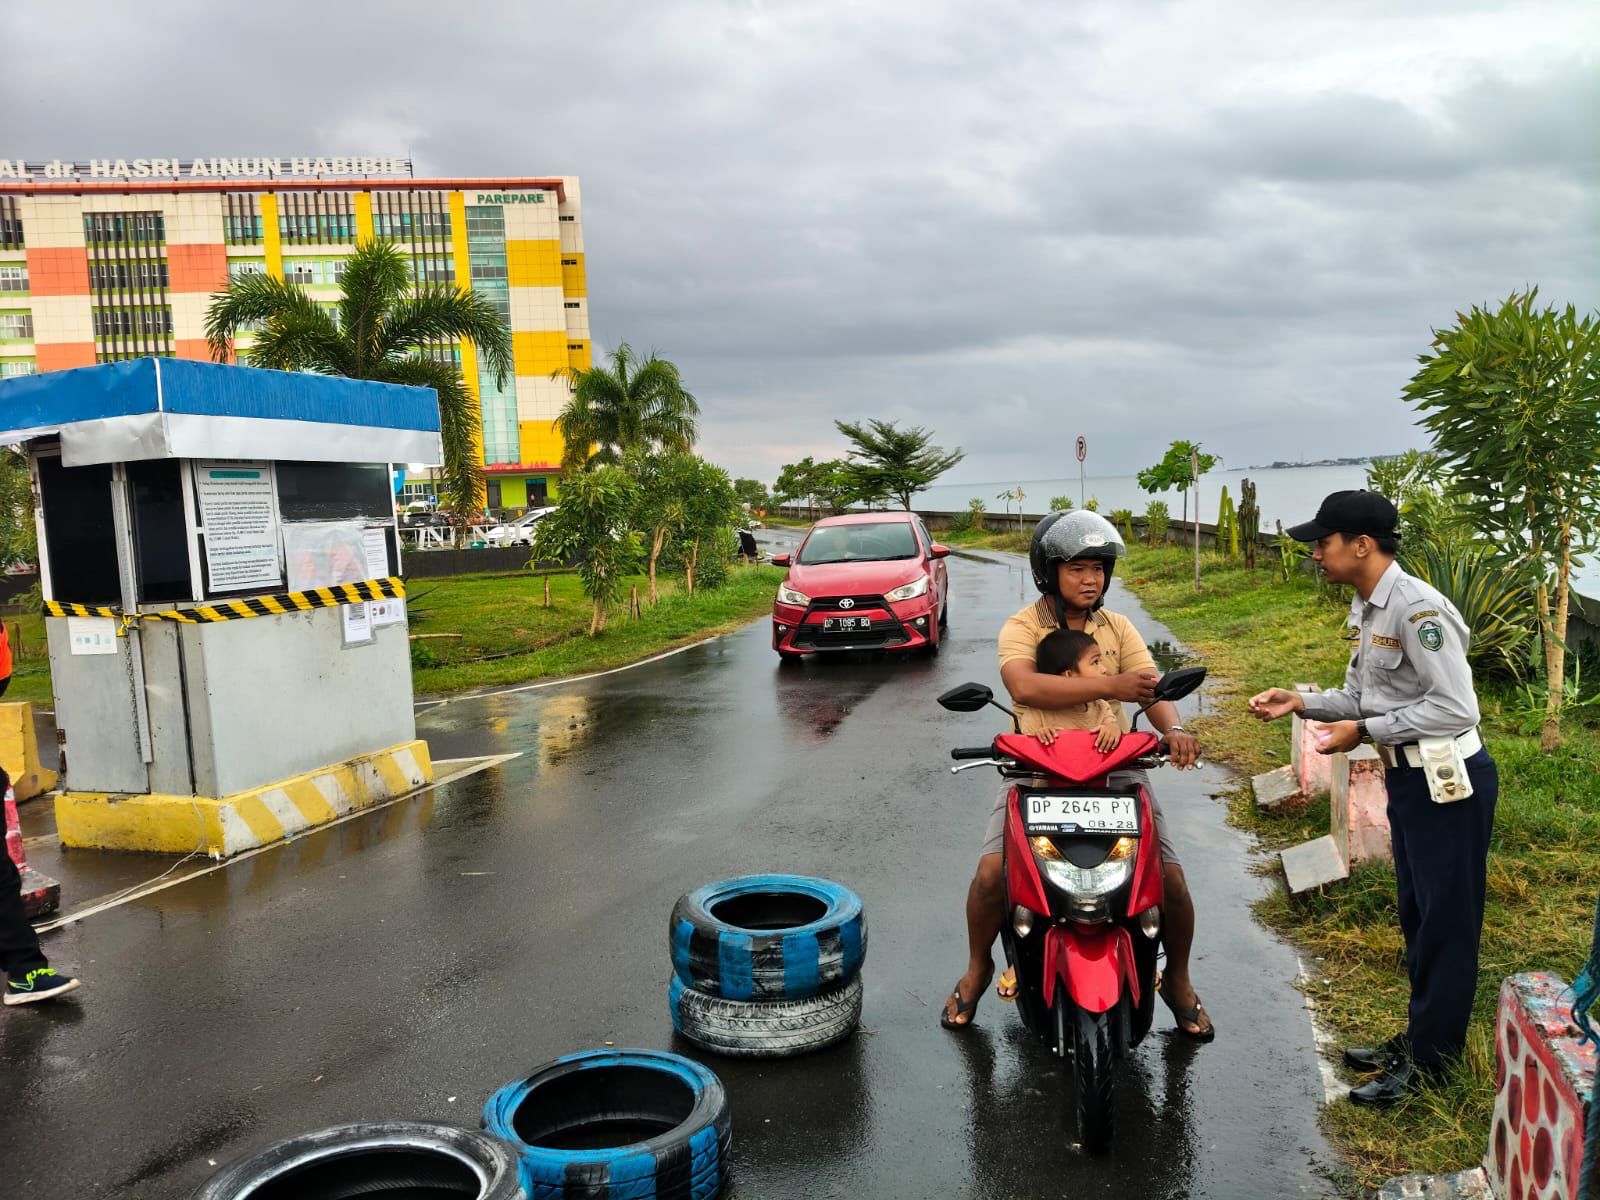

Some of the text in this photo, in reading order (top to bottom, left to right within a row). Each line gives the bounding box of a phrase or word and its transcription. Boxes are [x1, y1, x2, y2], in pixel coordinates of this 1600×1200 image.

[0, 157, 408, 178] AL dr. HASRI AINUN HABIBIE
[477, 194, 545, 204] PAREPARE
[1033, 800, 1131, 815] DP 2646 PY
